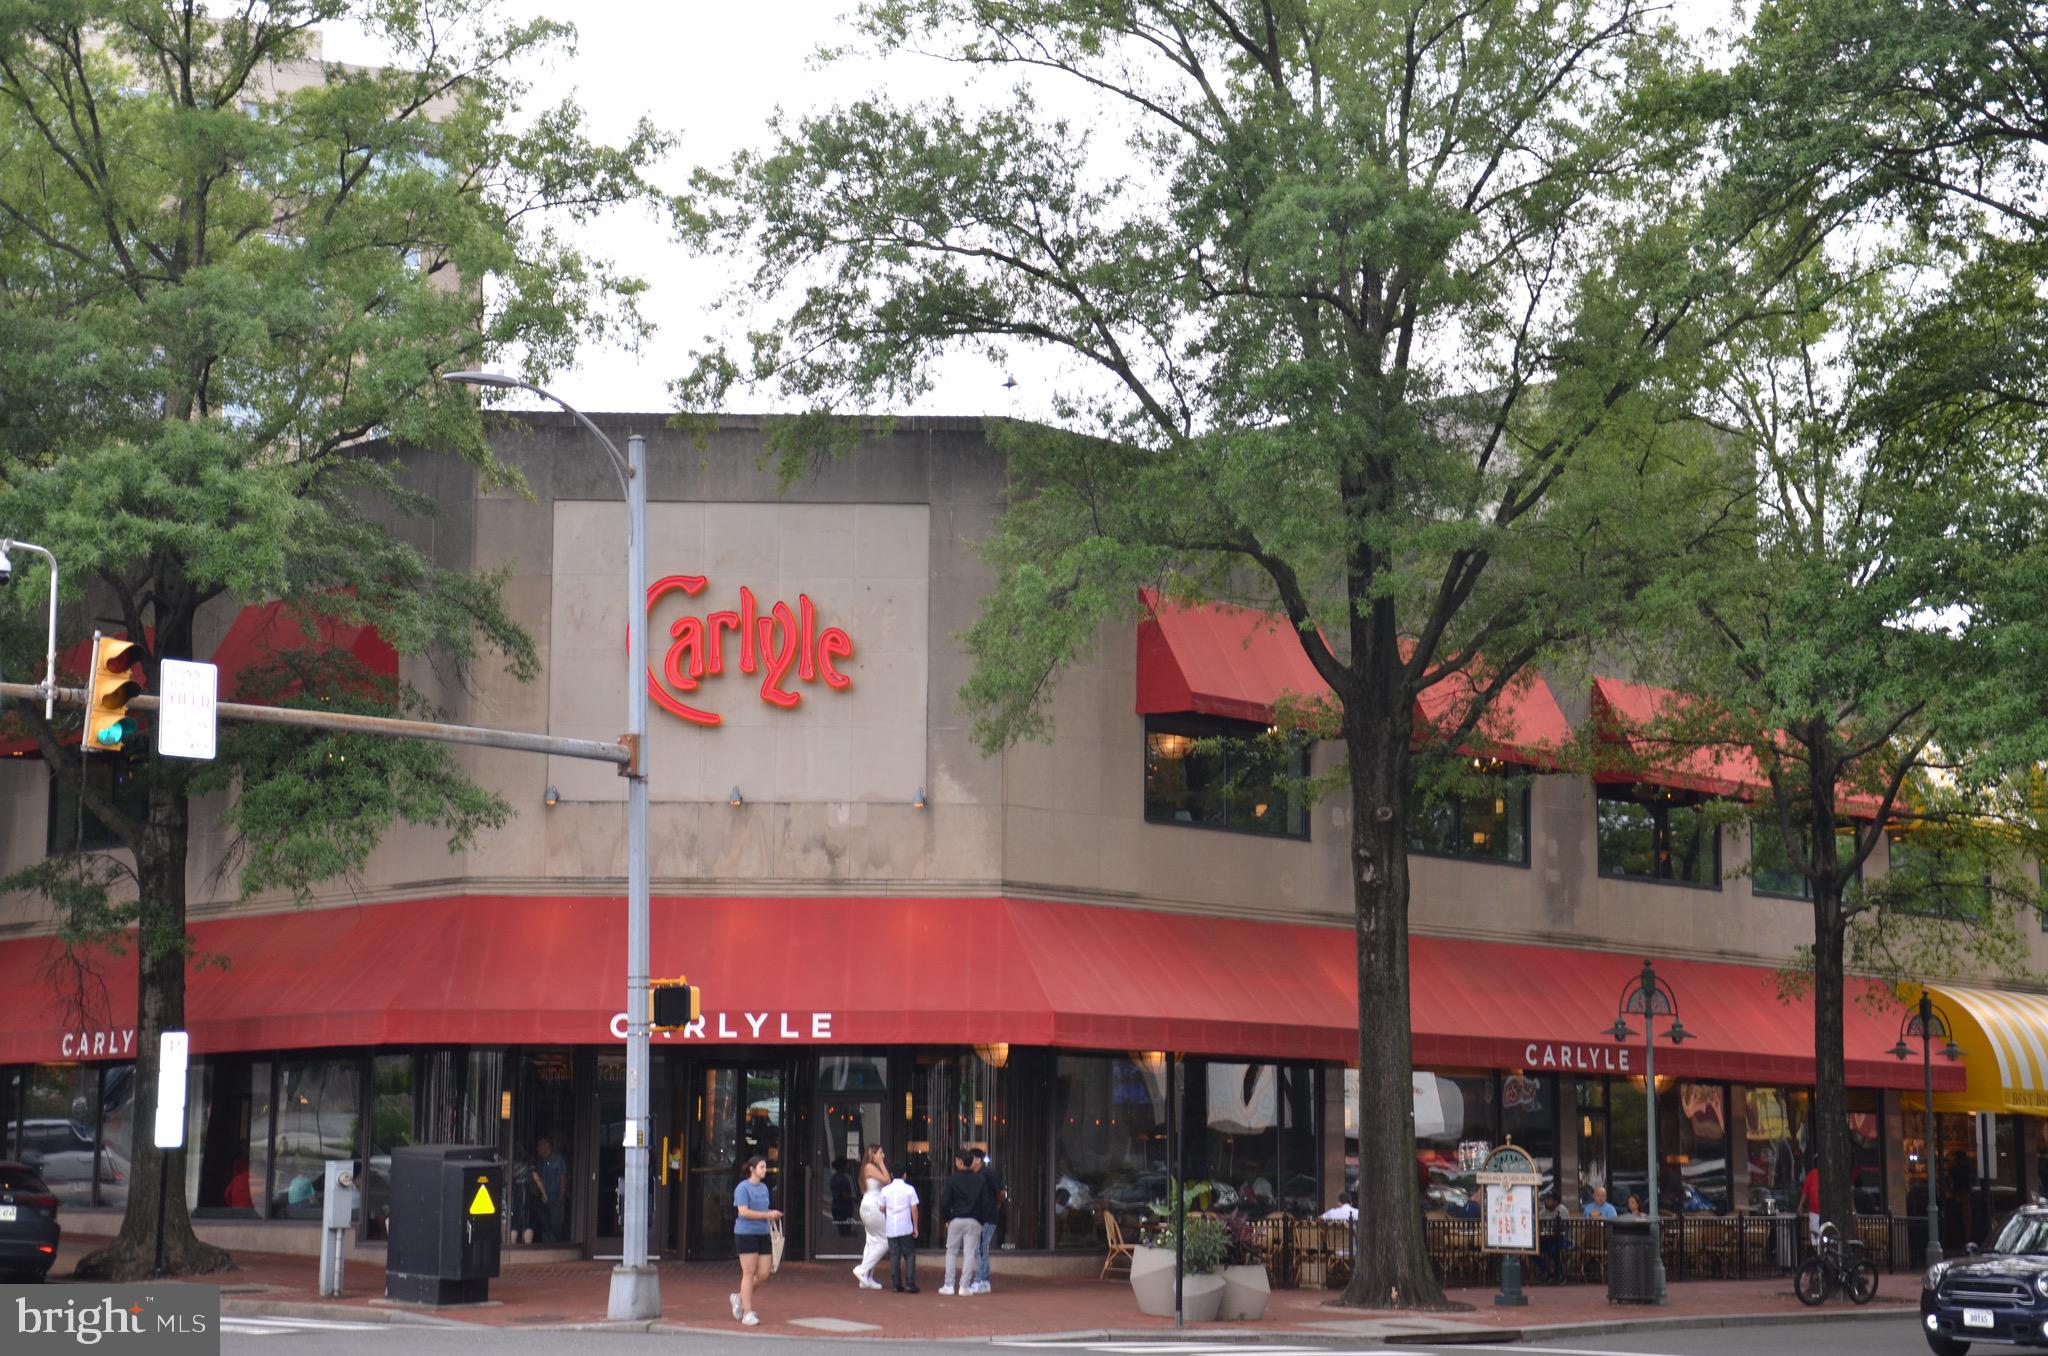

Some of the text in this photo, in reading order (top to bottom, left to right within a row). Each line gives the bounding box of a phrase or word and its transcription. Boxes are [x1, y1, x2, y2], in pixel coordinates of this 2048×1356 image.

[626, 575, 853, 727] Carlyle
[62, 1029, 134, 1057] CARLY
[1525, 1043, 1630, 1071] CARLYLE
